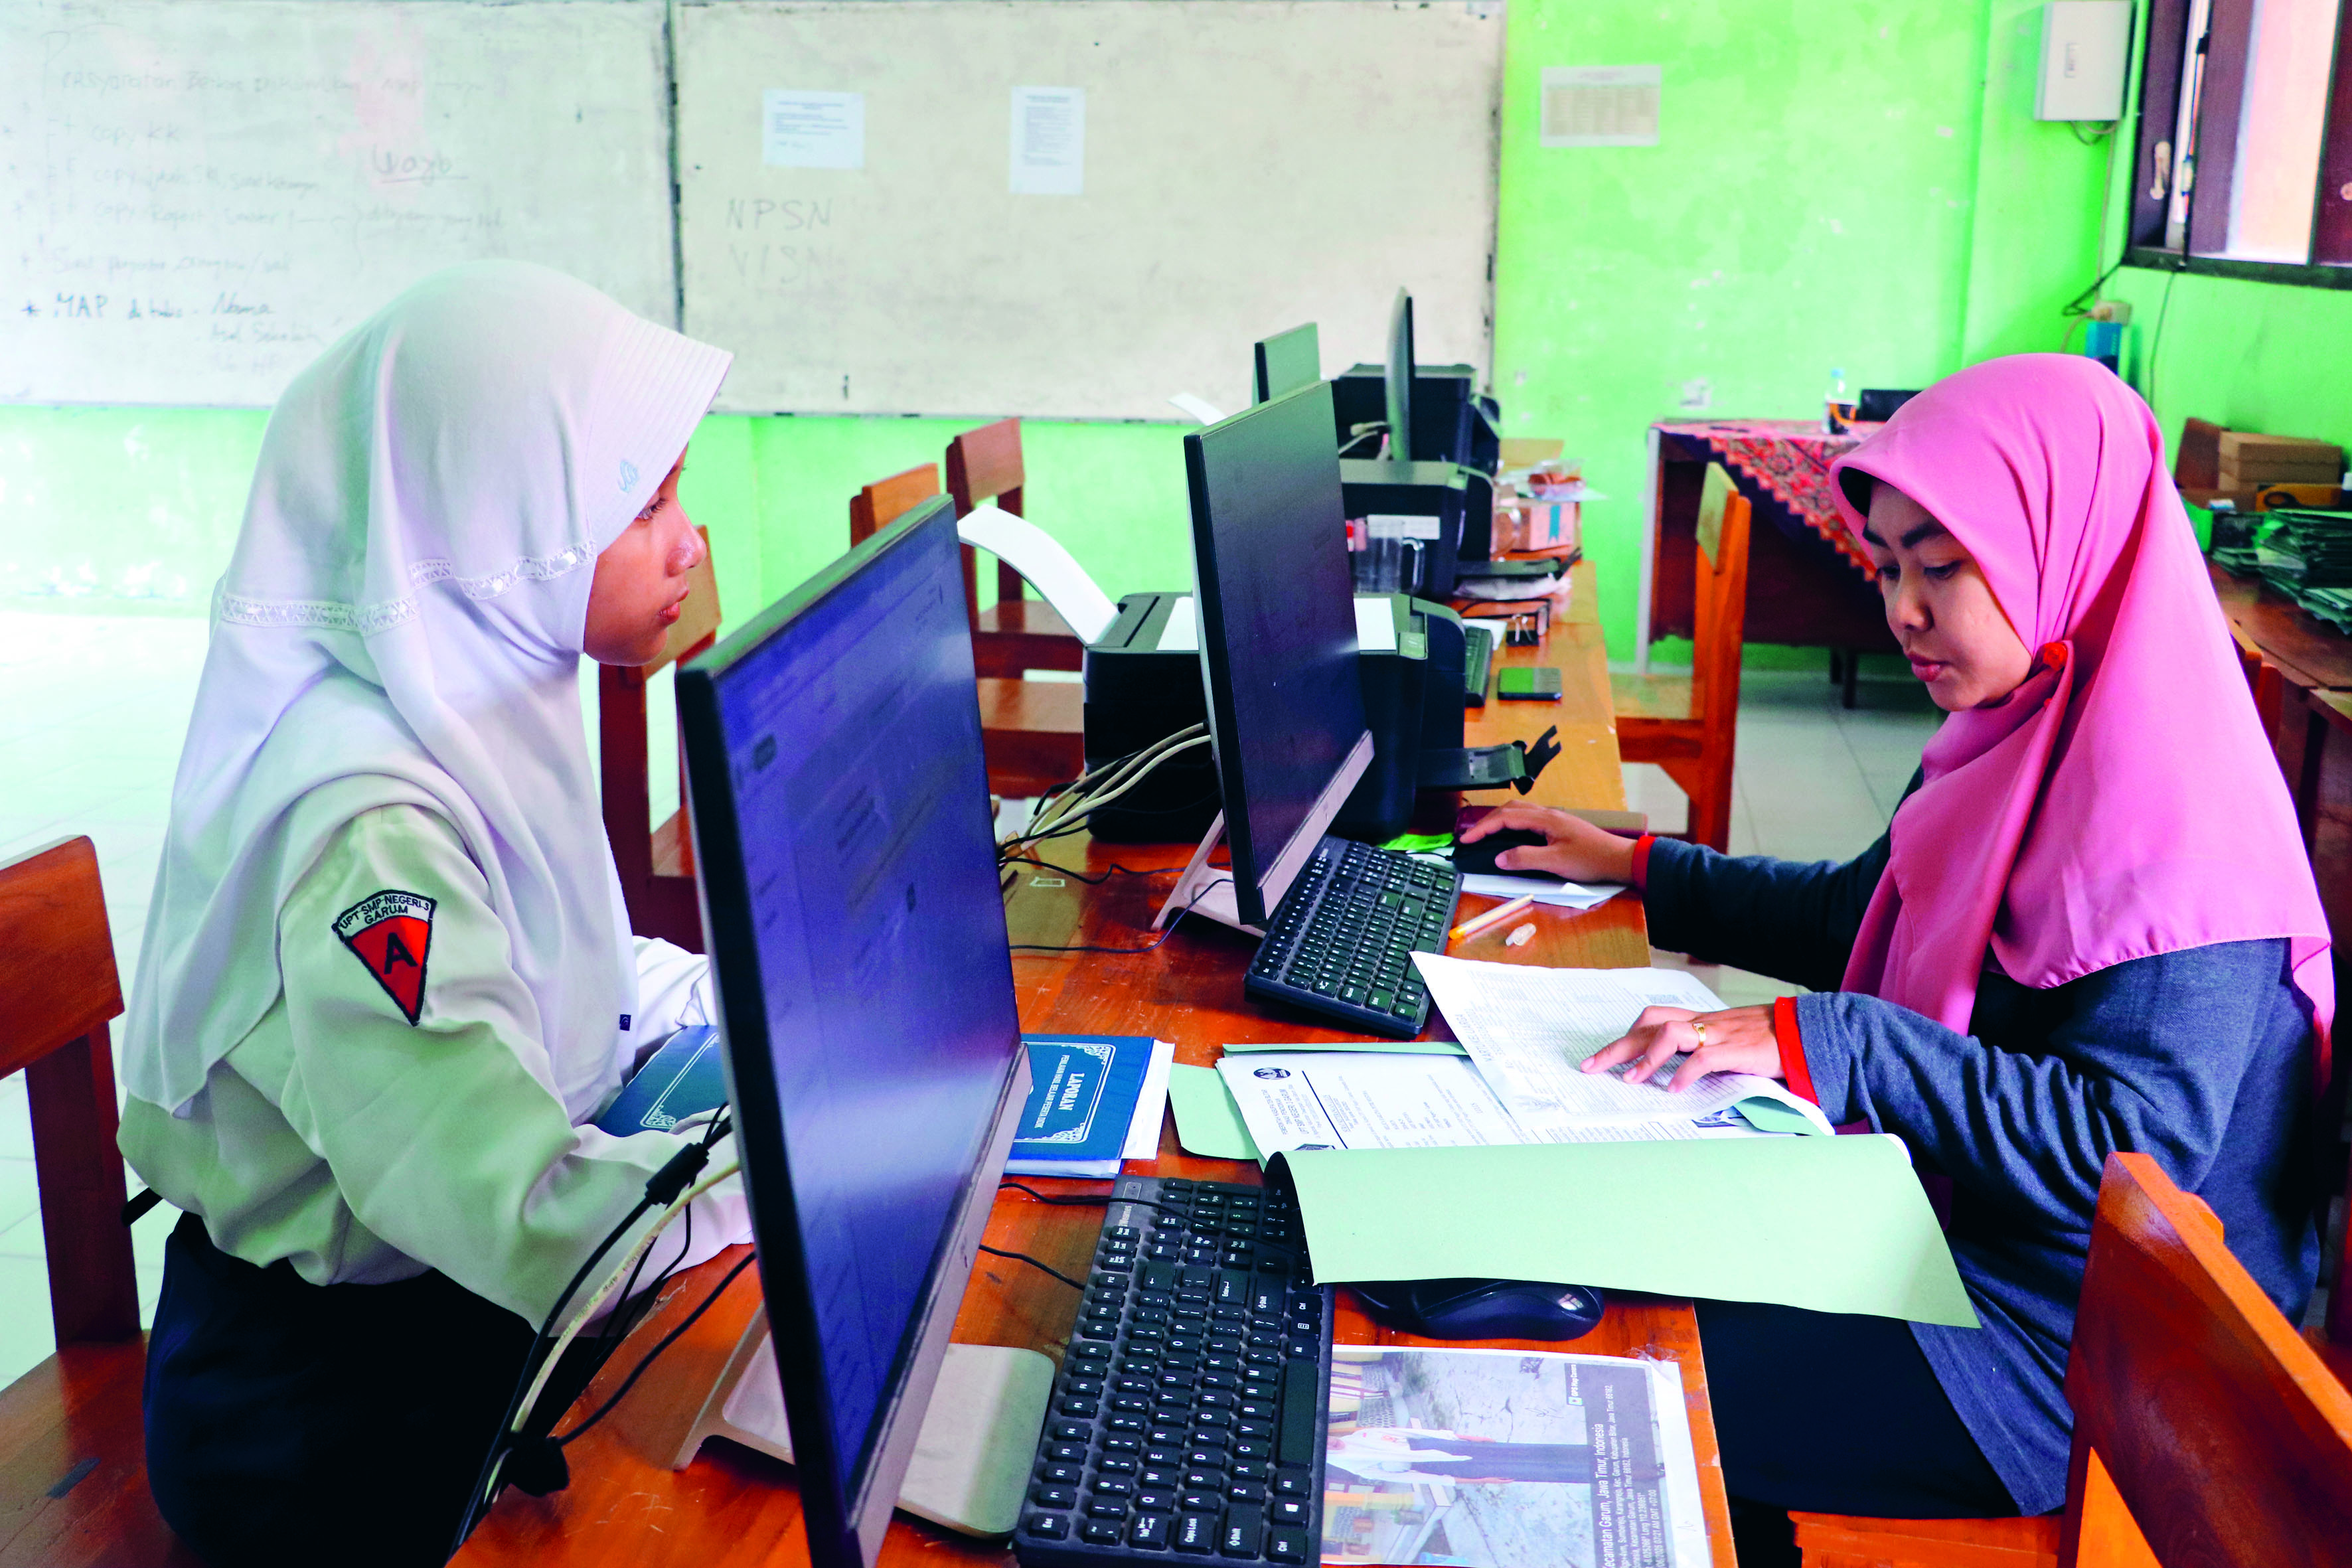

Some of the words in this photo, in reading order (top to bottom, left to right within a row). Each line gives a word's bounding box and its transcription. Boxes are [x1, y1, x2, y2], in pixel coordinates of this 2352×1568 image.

[726, 196, 832, 231] NPSN
[54, 292, 108, 319] MAP
[339, 910, 359, 929] UPT
[361, 898, 382, 915] SMP
[384, 894, 422, 908] NEGERI
[424, 902, 430, 911] 3
[364, 905, 408, 924] GARUM
[384, 932, 418, 975] A
[1058, 1073, 1085, 1111] LAPORAN
[1591, 1423, 1606, 1455] Indonesia
[1595, 1457, 1609, 1478] Timur,
[1597, 1480, 1609, 1498] Jawa
[1599, 1500, 1612, 1527] Garum,
[1650, 1508, 1660, 1520] GMT
[1652, 1521, 1661, 1529] AM
[1600, 1529, 1615, 1568] ecamatan
